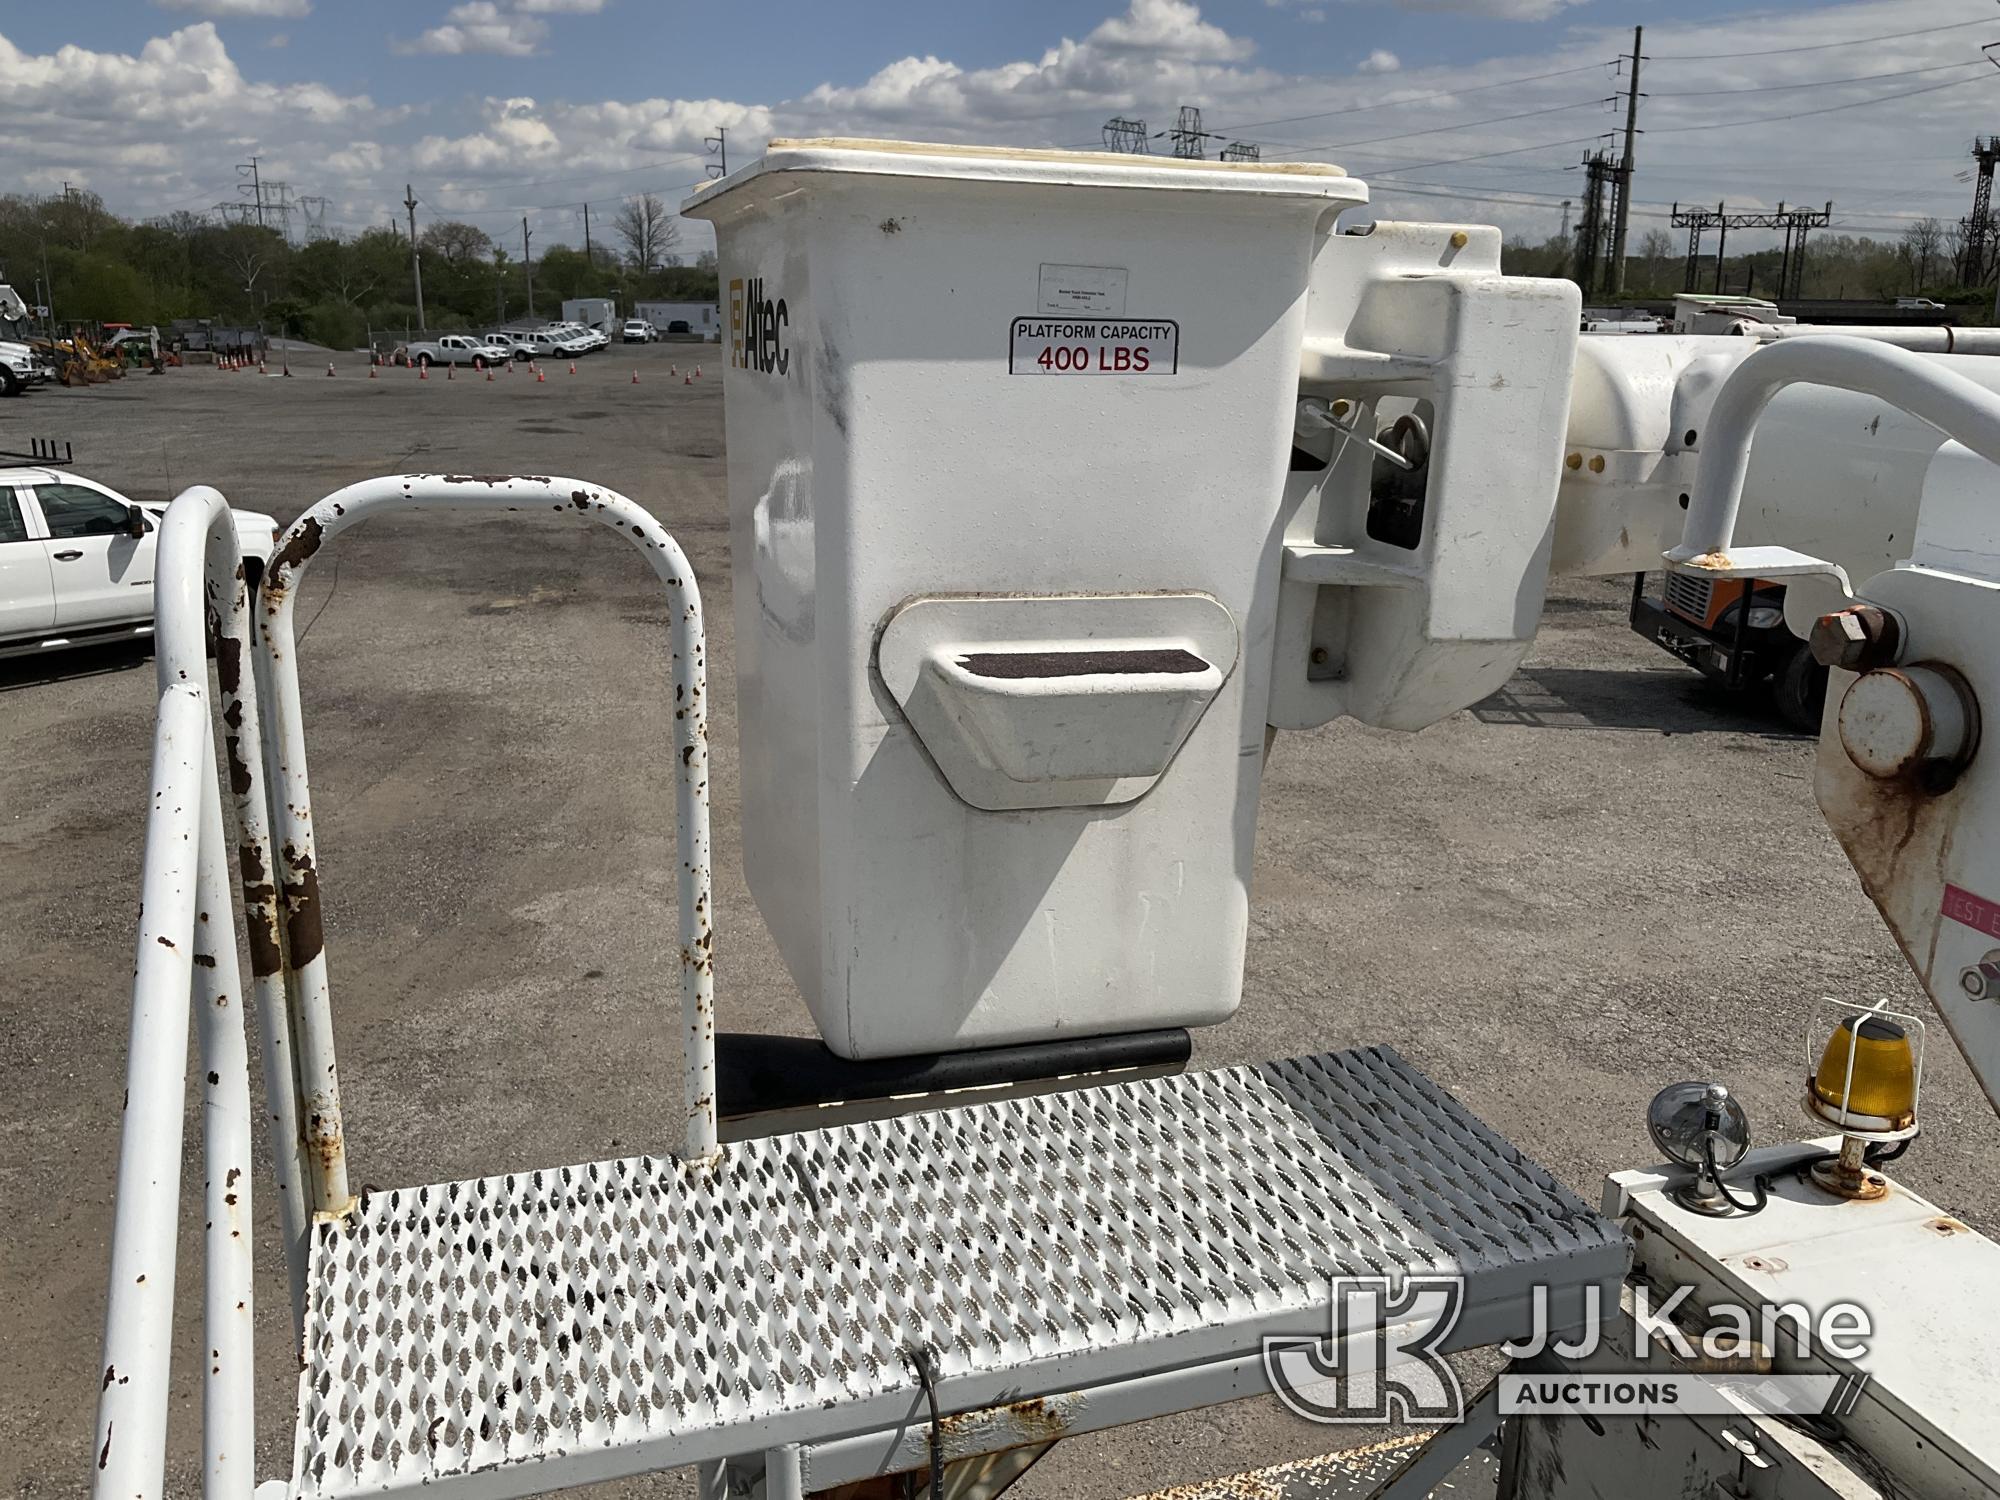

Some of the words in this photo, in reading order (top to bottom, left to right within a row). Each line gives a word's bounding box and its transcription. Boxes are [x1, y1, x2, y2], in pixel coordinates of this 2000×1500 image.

[745, 278, 788, 375] Altec
[1018, 324, 1095, 339] PLATFORM
[1100, 325, 1171, 339] CAPACITY
[1037, 346, 1089, 371] 400
[1099, 346, 1150, 371] LBS
